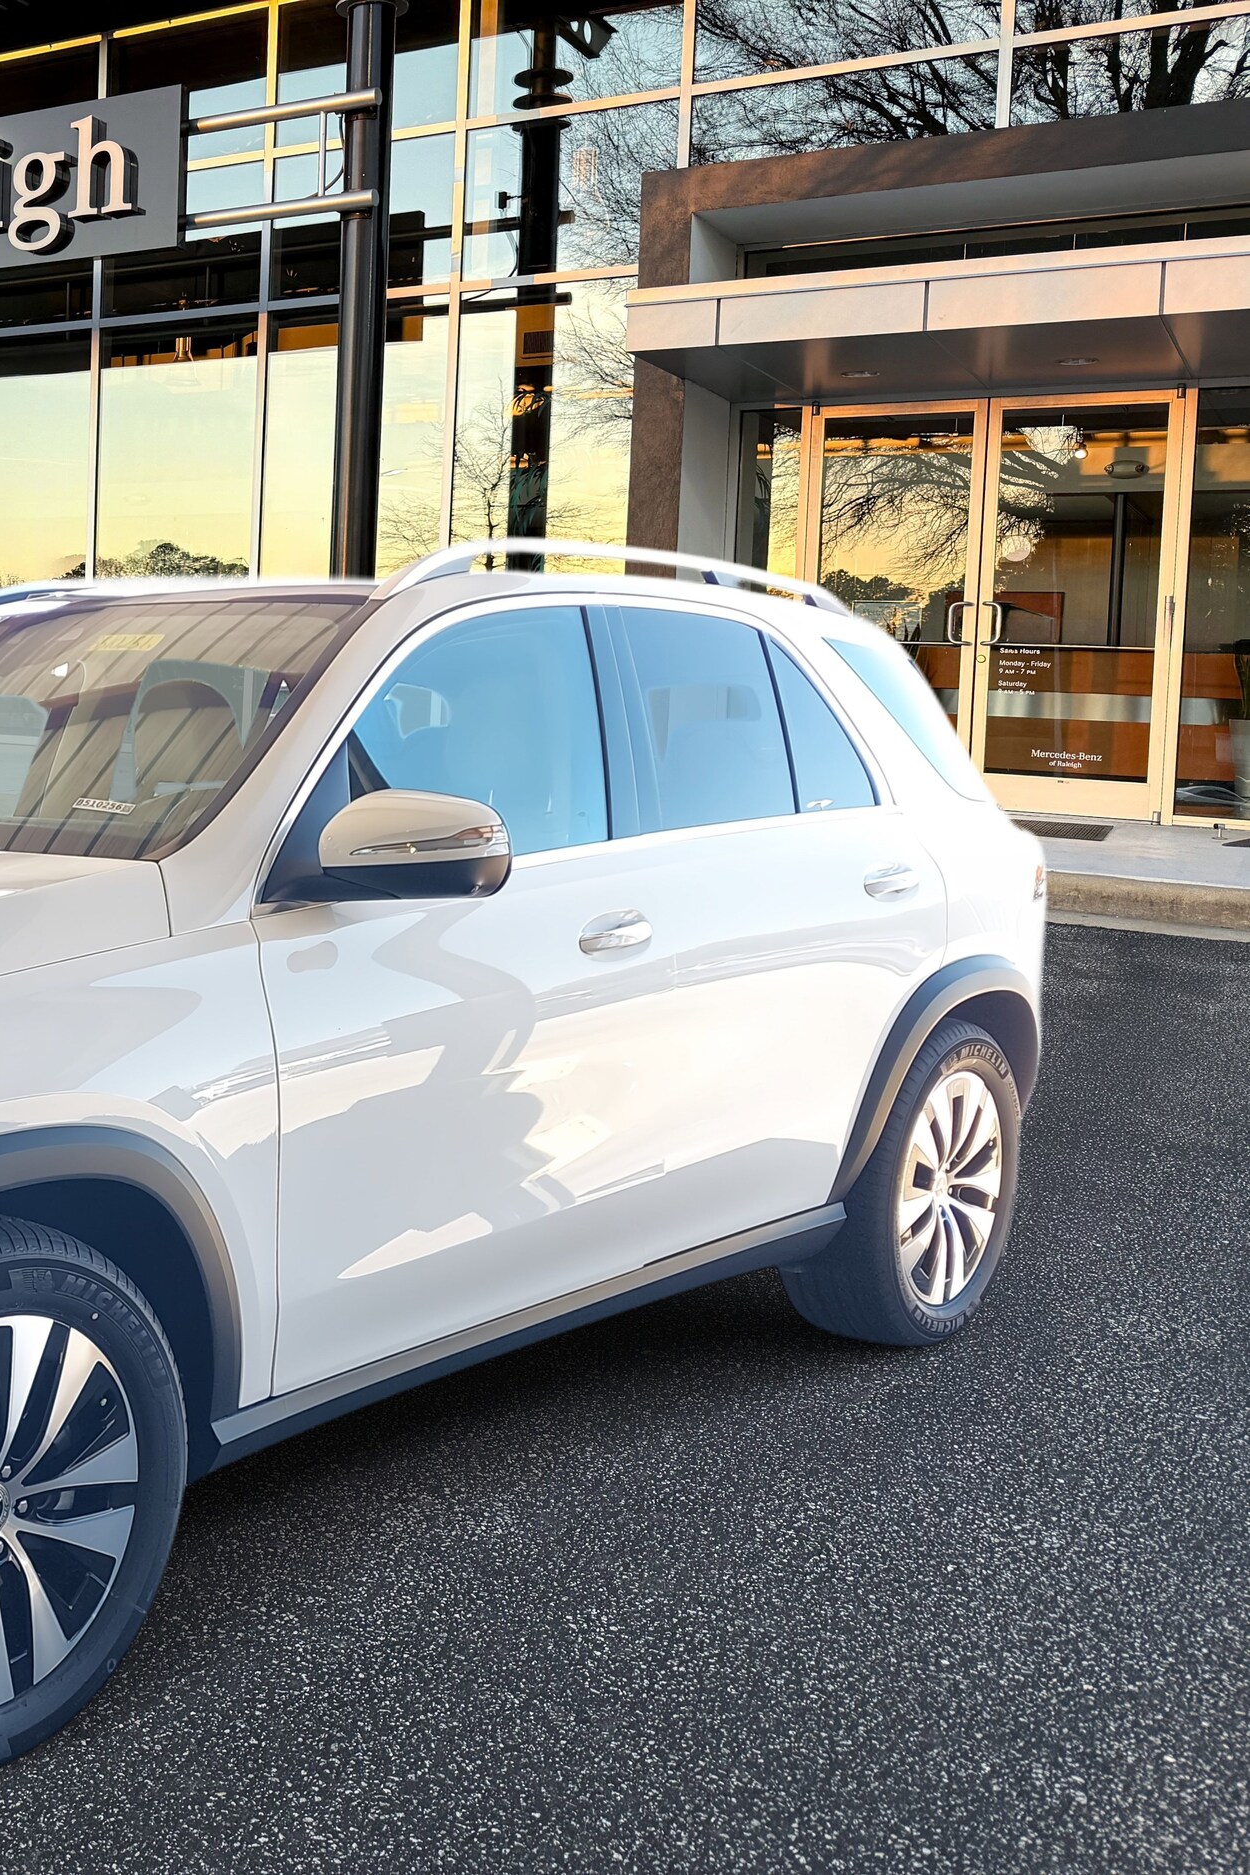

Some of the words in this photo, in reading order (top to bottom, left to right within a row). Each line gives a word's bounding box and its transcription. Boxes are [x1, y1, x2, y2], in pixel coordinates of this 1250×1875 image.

[999, 660, 1025, 668] Monday
[998, 680, 1027, 688] Saturday
[1031, 749, 1102, 761] Mercedes-Benz
[1057, 761, 1082, 769] Raleigh
[959, 1044, 1007, 1076] MICHELIN
[913, 1309, 965, 1333] MICHELIN
[59, 1274, 170, 1386] MICHELIN
